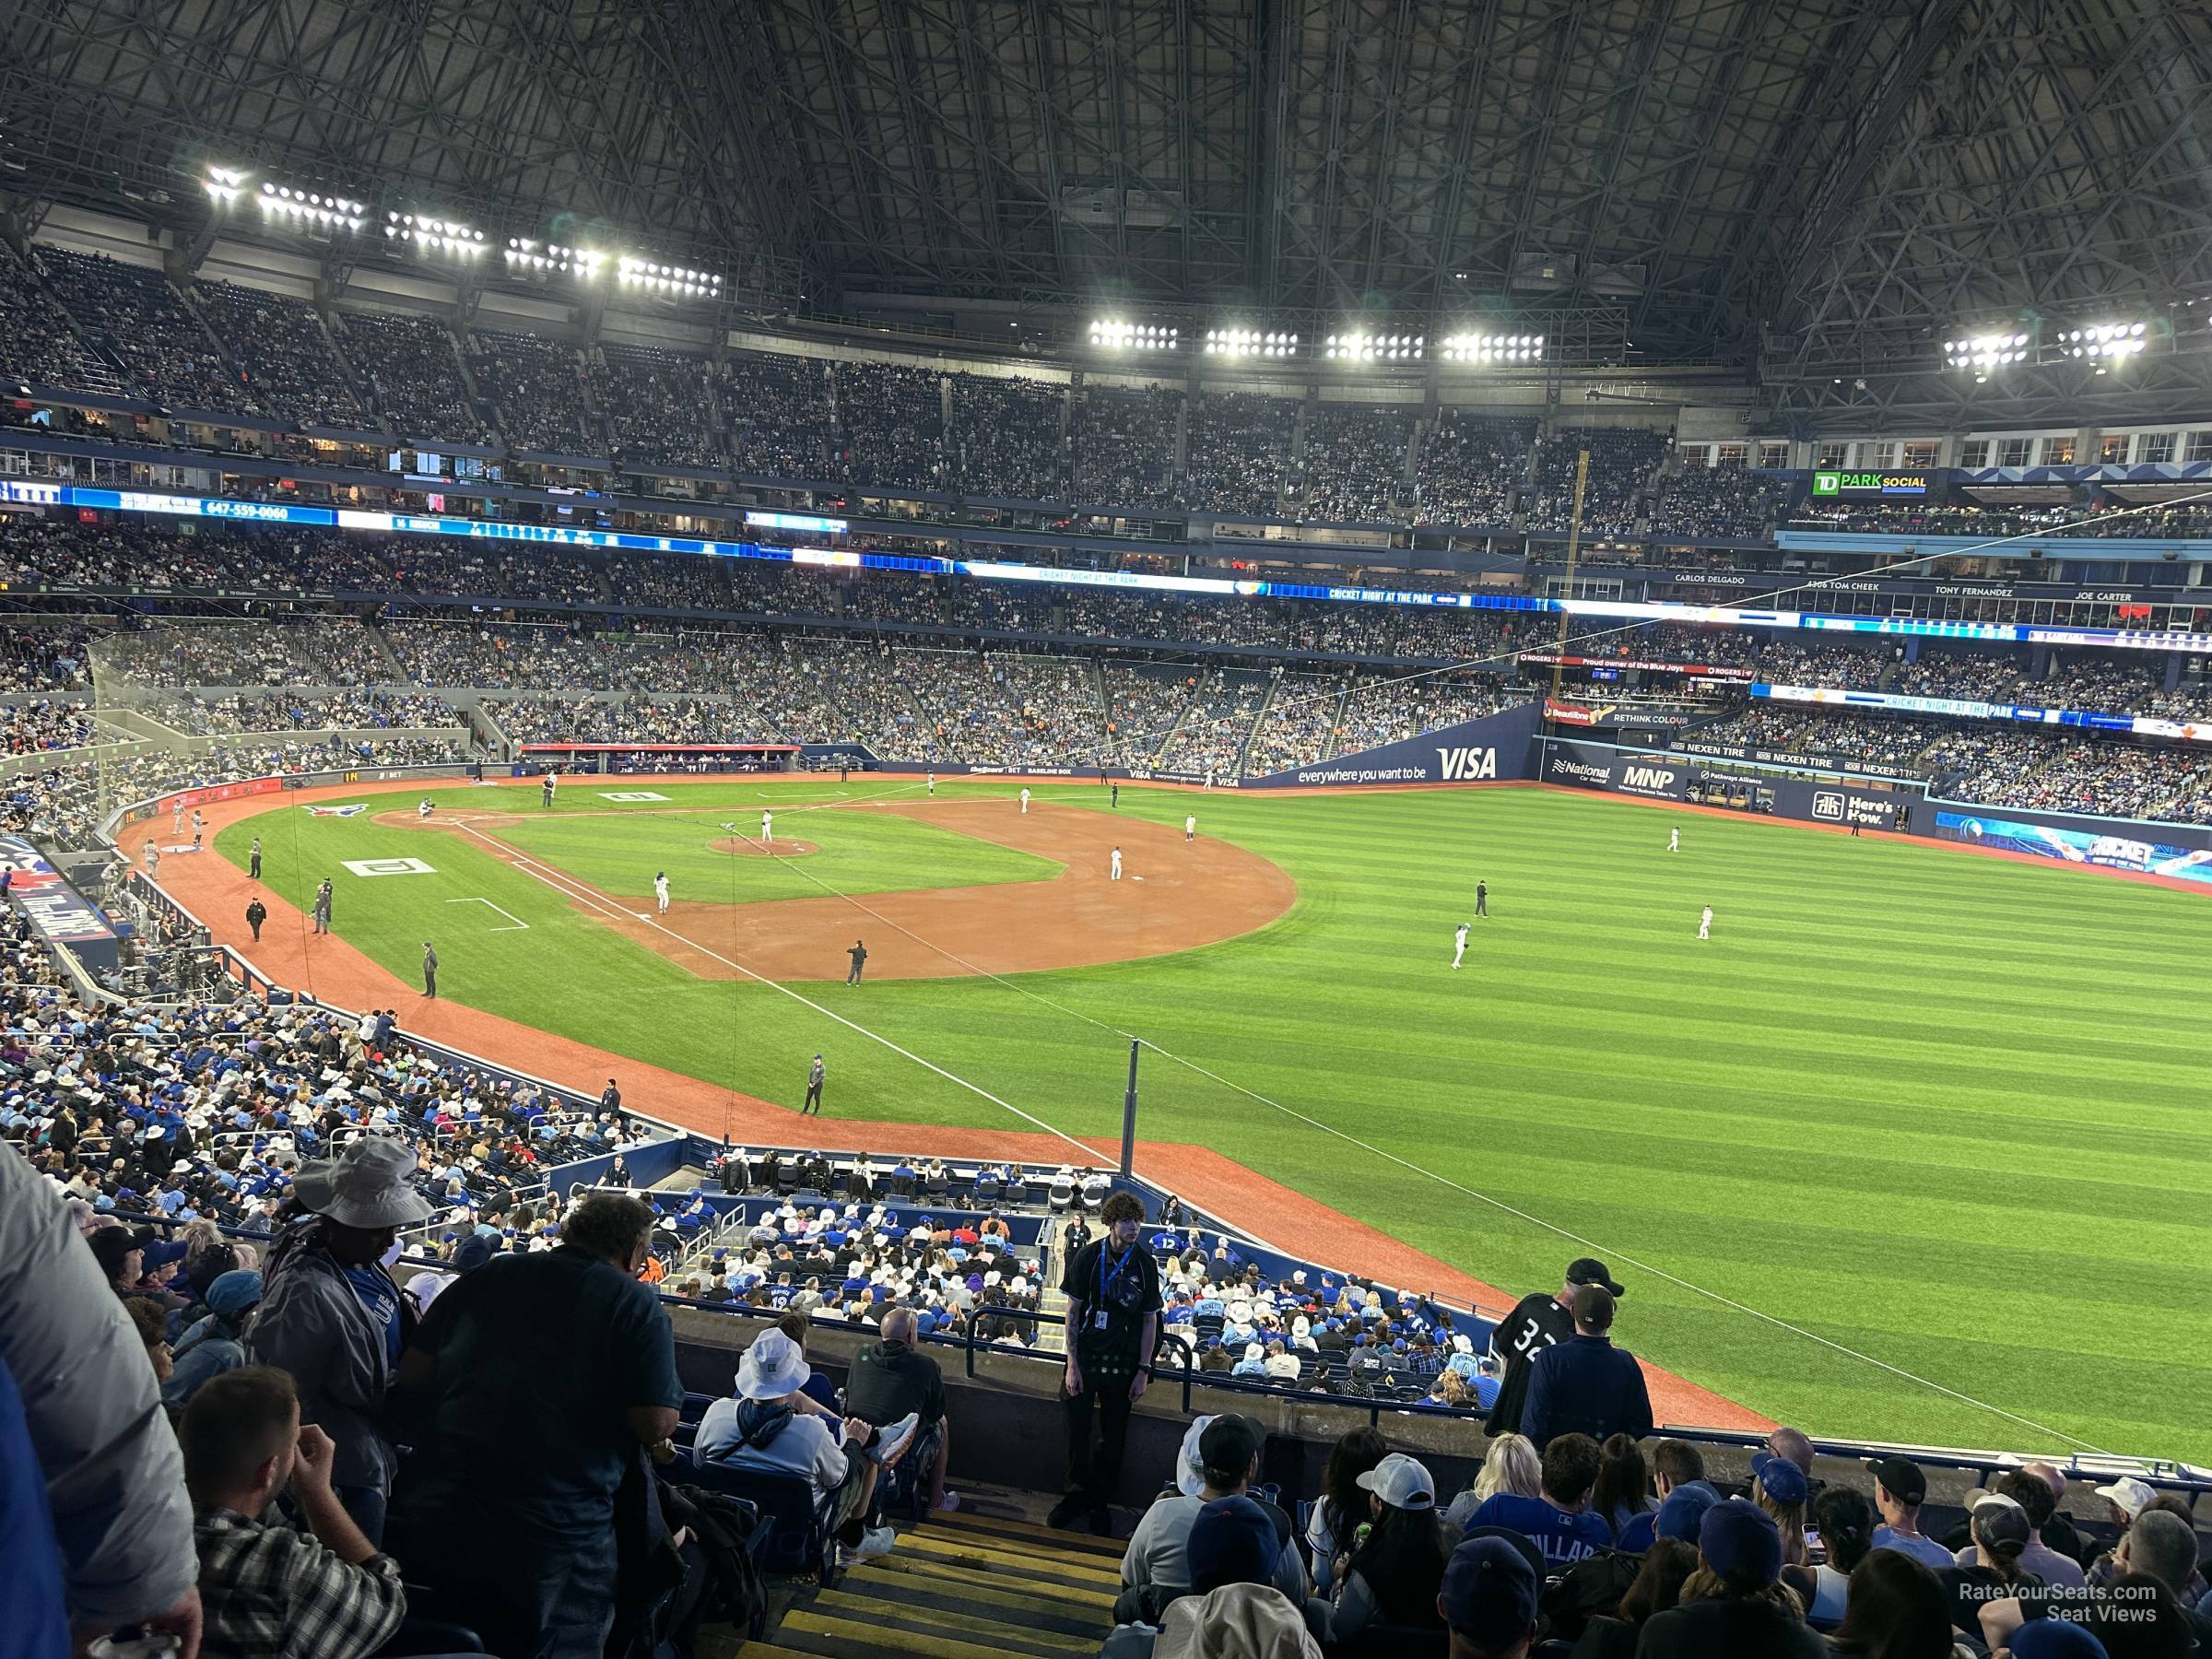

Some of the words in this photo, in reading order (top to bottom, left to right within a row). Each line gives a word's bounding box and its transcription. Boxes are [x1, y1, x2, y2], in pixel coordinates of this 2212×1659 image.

[1817, 476, 1838, 490] TD
[1841, 474, 1882, 487] PARK
[1882, 477, 1926, 487] SOCIAL
[206, 502, 288, 520] 647-559-0060
[1675, 574, 1705, 582] CARLOS
[1708, 575, 1745, 584] DELGADO
[1830, 582, 1849, 590] TOM
[1851, 582, 1879, 591] CHEEK
[1935, 585, 1959, 594] TONY
[1962, 587, 2013, 597] FERNANDEZ
[1329, 589, 1360, 600] CRICKET
[1362, 590, 1385, 601] NIGHT
[1385, 591, 1396, 602] AT
[1397, 592, 1412, 603] THE
[1413, 593, 1432, 604] PARK
[2076, 592, 2094, 600] JOE
[2096, 593, 2132, 602] CARTER
[1666, 665, 1685, 674] Jays
[1715, 668, 1741, 677] ROGERS
[1887, 698, 1923, 708] CRICKET
[1926, 700, 1952, 712] NIGHT
[1955, 702, 1966, 713] AT
[1970, 705, 1986, 715] THE
[1988, 705, 2014, 718] PARK
[1614, 713, 1652, 724] RETHINK
[1652, 717, 1688, 725] COLOUR
[1687, 743, 1721, 754] NEXEN
[1722, 747, 1746, 758] TIRE
[1435, 747, 1496, 780] VISA
[1773, 754, 1808, 765] NEXEN
[1809, 757, 1833, 768] TIRE
[1129, 770, 1151, 780] VISA
[1299, 769, 1357, 783] everywhere
[1358, 771, 1378, 782] you
[1378, 769, 1402, 781] want
[1402, 768, 1413, 778] to
[1414, 767, 1426, 778] be
[1565, 762, 1609, 779] National
[1862, 763, 1898, 776] NEXEN
[1217, 777, 1239, 787] VISA
[1623, 766, 1675, 789] MNP
[1711, 772, 1738, 782] Pathways
[1739, 775, 1762, 784] Alliance
[1849, 796, 1893, 814] Here's
[856, 1167, 866, 1176] 26
[1162, 1238, 1175, 1250] 12
[373, 1294, 394, 1324] UE
[1513, 1318, 1557, 1362] 32
